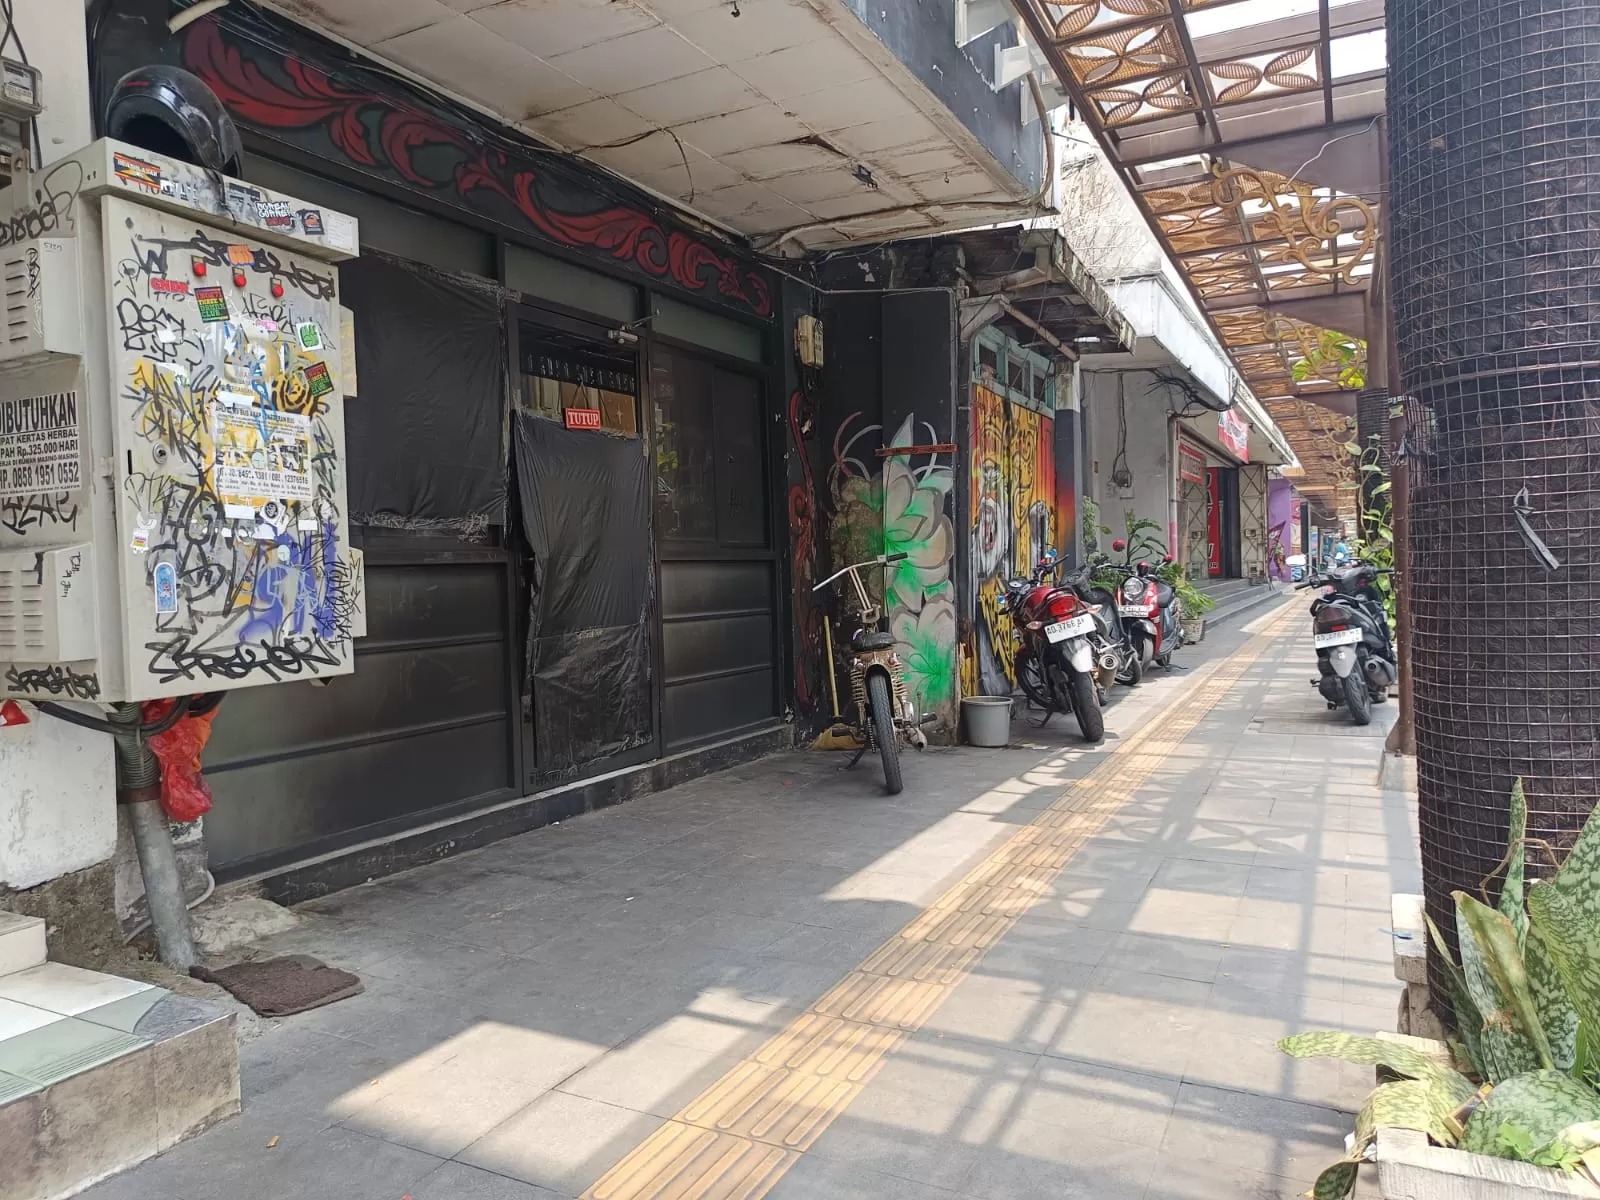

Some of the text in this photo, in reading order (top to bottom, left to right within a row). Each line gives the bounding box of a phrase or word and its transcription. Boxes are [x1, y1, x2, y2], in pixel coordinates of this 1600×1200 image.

[567, 411, 599, 425] TUTUP
[17, 432, 46, 443] KERTAS
[48, 428, 78, 440] HERBAL
[13, 466, 32, 488] 0858
[35, 463, 55, 486] 1951
[58, 461, 79, 483] 0552
